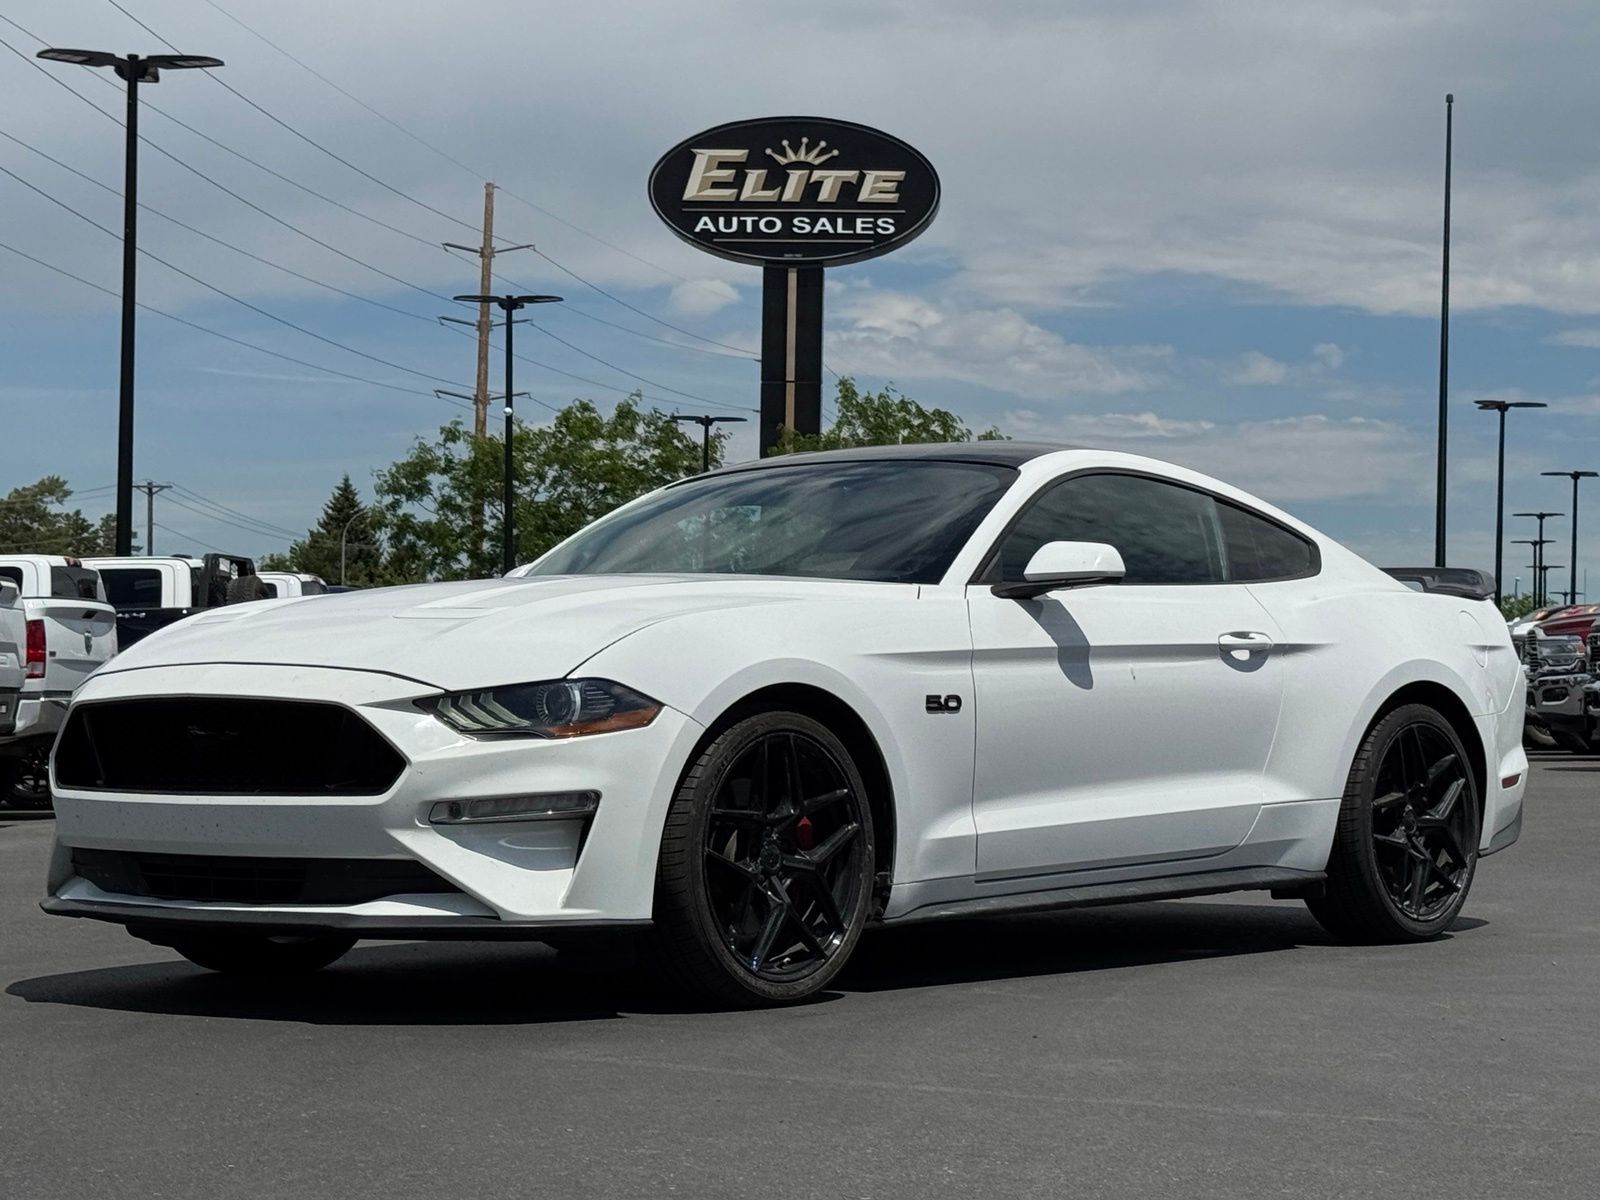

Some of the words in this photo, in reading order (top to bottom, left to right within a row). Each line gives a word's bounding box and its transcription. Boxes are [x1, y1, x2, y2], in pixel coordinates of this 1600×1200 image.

[682, 149, 906, 203] ELITE
[694, 216, 783, 233] AUTO
[792, 217, 896, 234] SALES
[926, 694, 962, 714] 5.0
